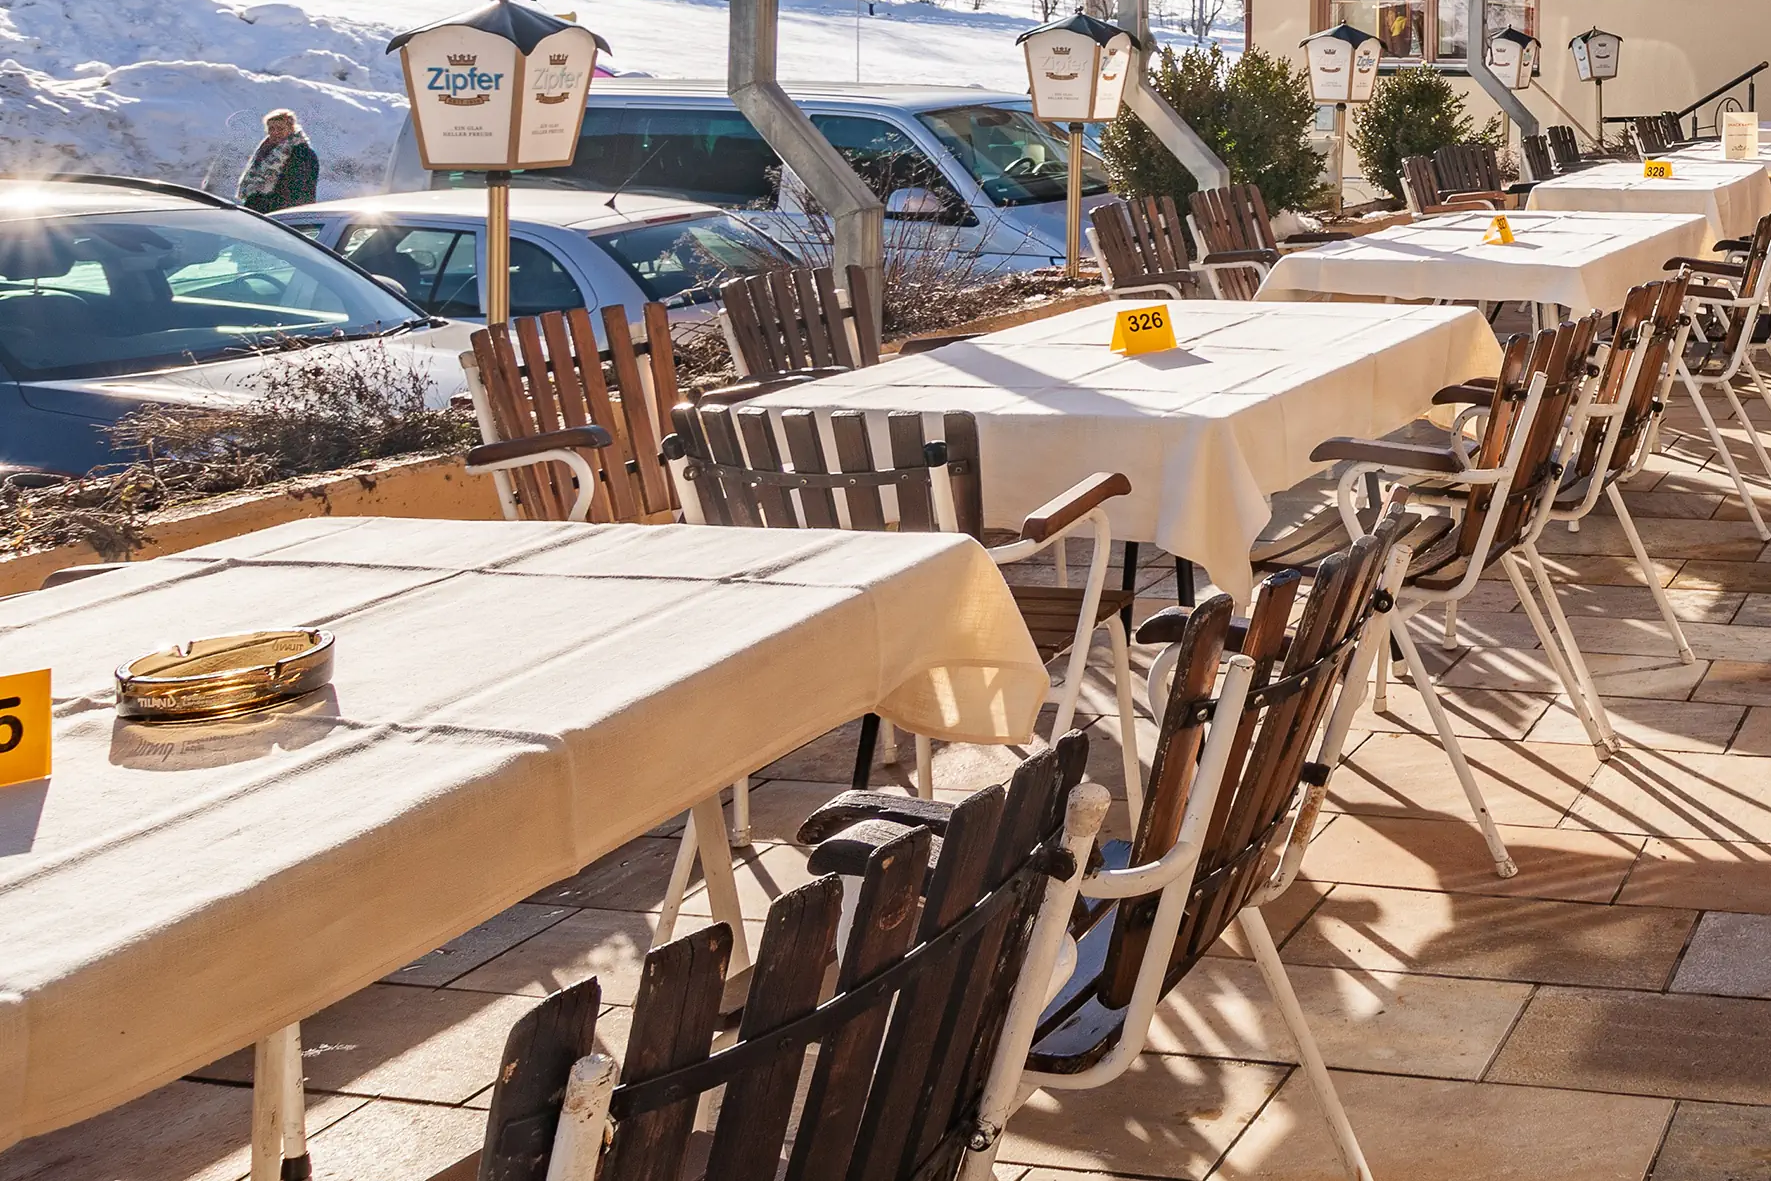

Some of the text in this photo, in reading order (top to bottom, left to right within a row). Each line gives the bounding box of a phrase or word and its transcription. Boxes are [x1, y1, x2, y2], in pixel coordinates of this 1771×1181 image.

[427, 66, 504, 96] Zipfer
[531, 66, 583, 95] Zipfer
[1646, 166, 1665, 177] 328
[1127, 311, 1163, 333] 326
